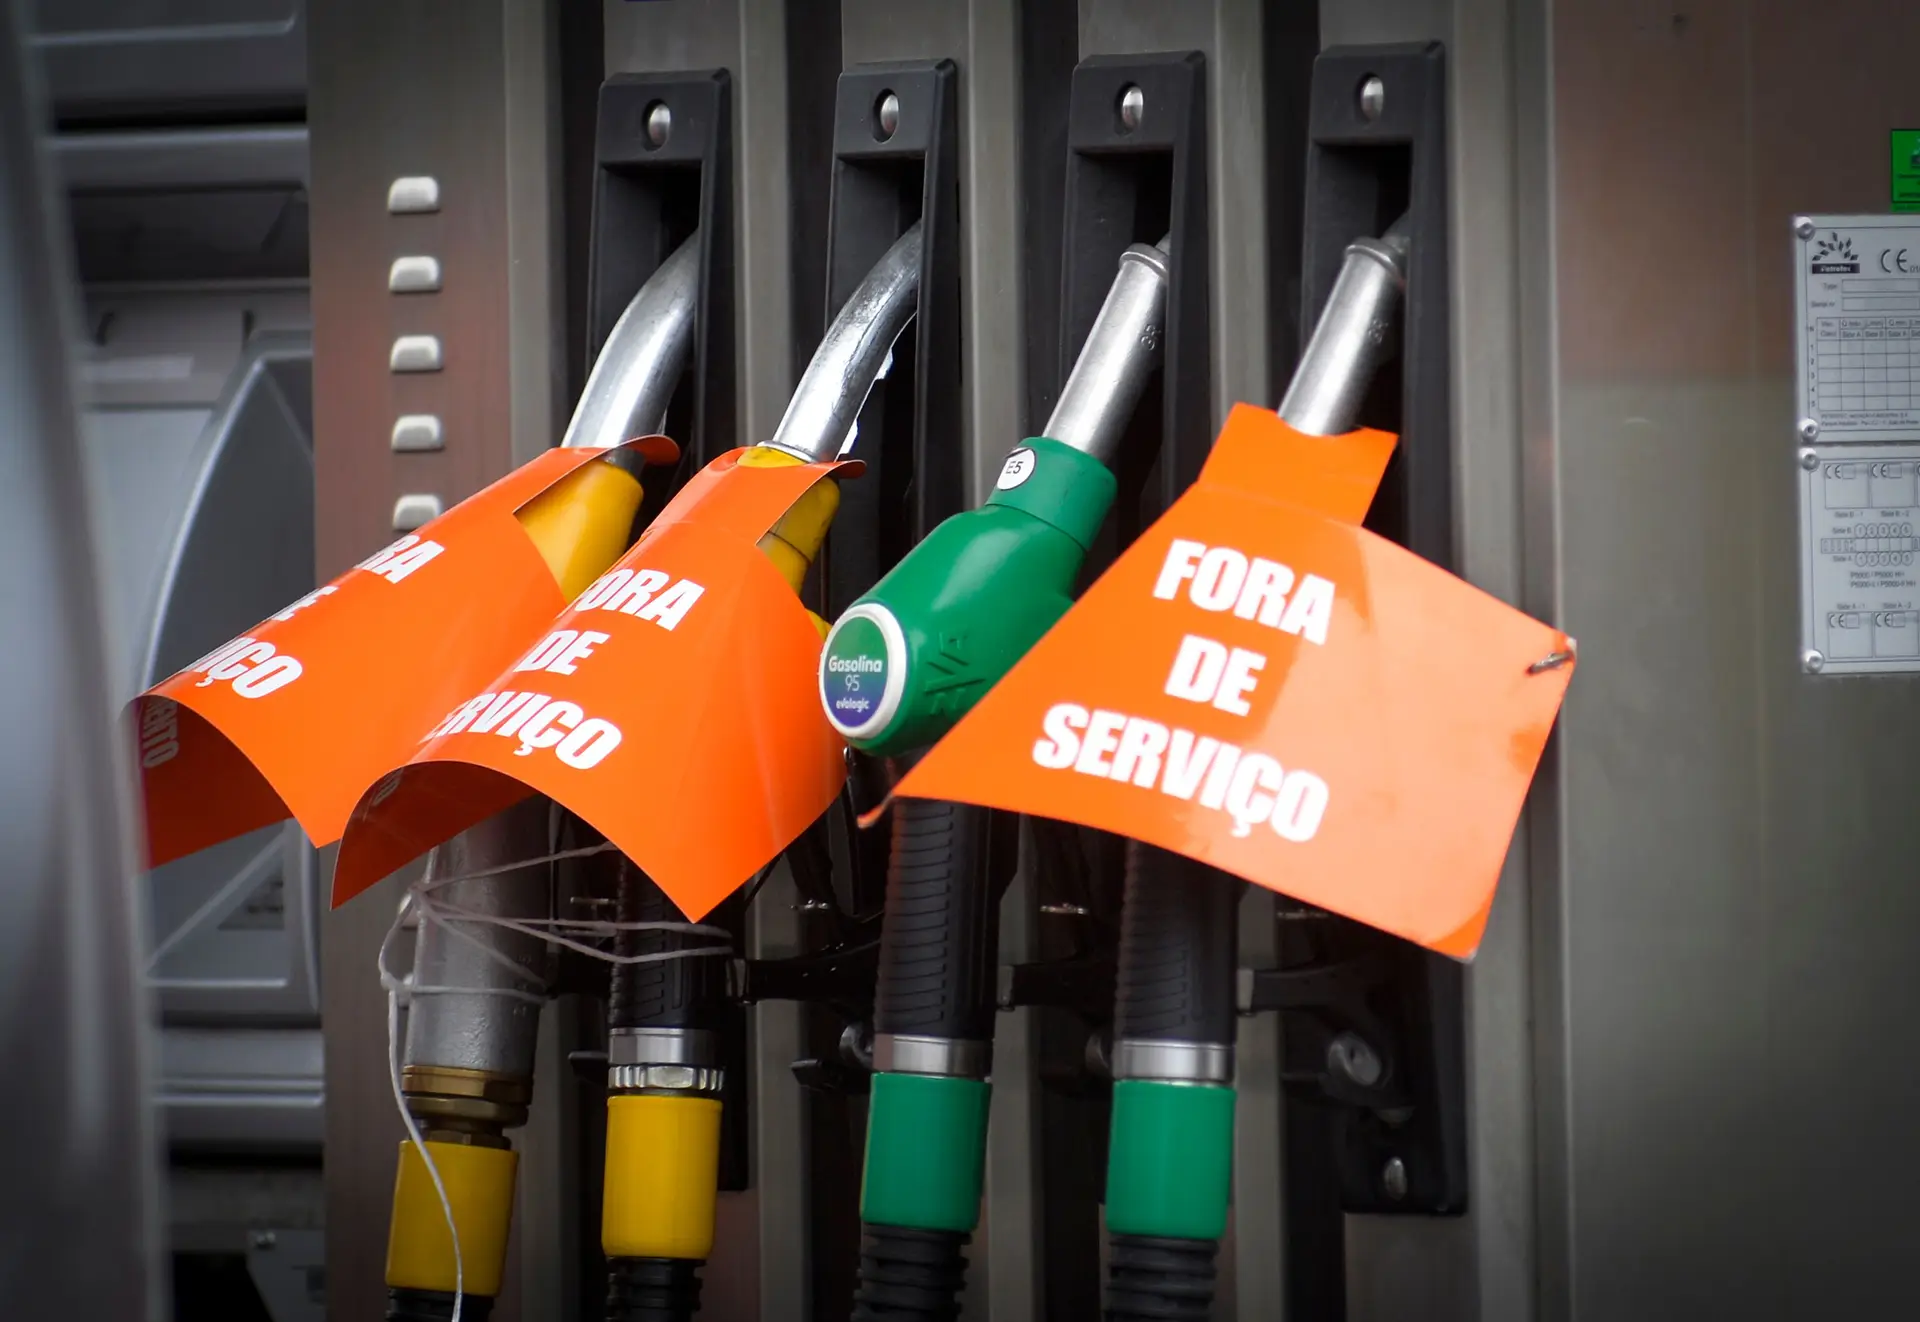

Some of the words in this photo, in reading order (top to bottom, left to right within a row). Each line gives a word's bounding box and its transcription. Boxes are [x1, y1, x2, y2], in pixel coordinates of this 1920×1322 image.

[1005, 460, 1024, 475] E5
[573, 567, 706, 632] ORA
[1153, 538, 1336, 647] FORA
[512, 629, 611, 676] DE
[828, 654, 883, 673] Gasolina
[1164, 633, 1267, 718] DE
[845, 674, 860, 692] 95
[1031, 702, 1330, 843] SERVIÇO
